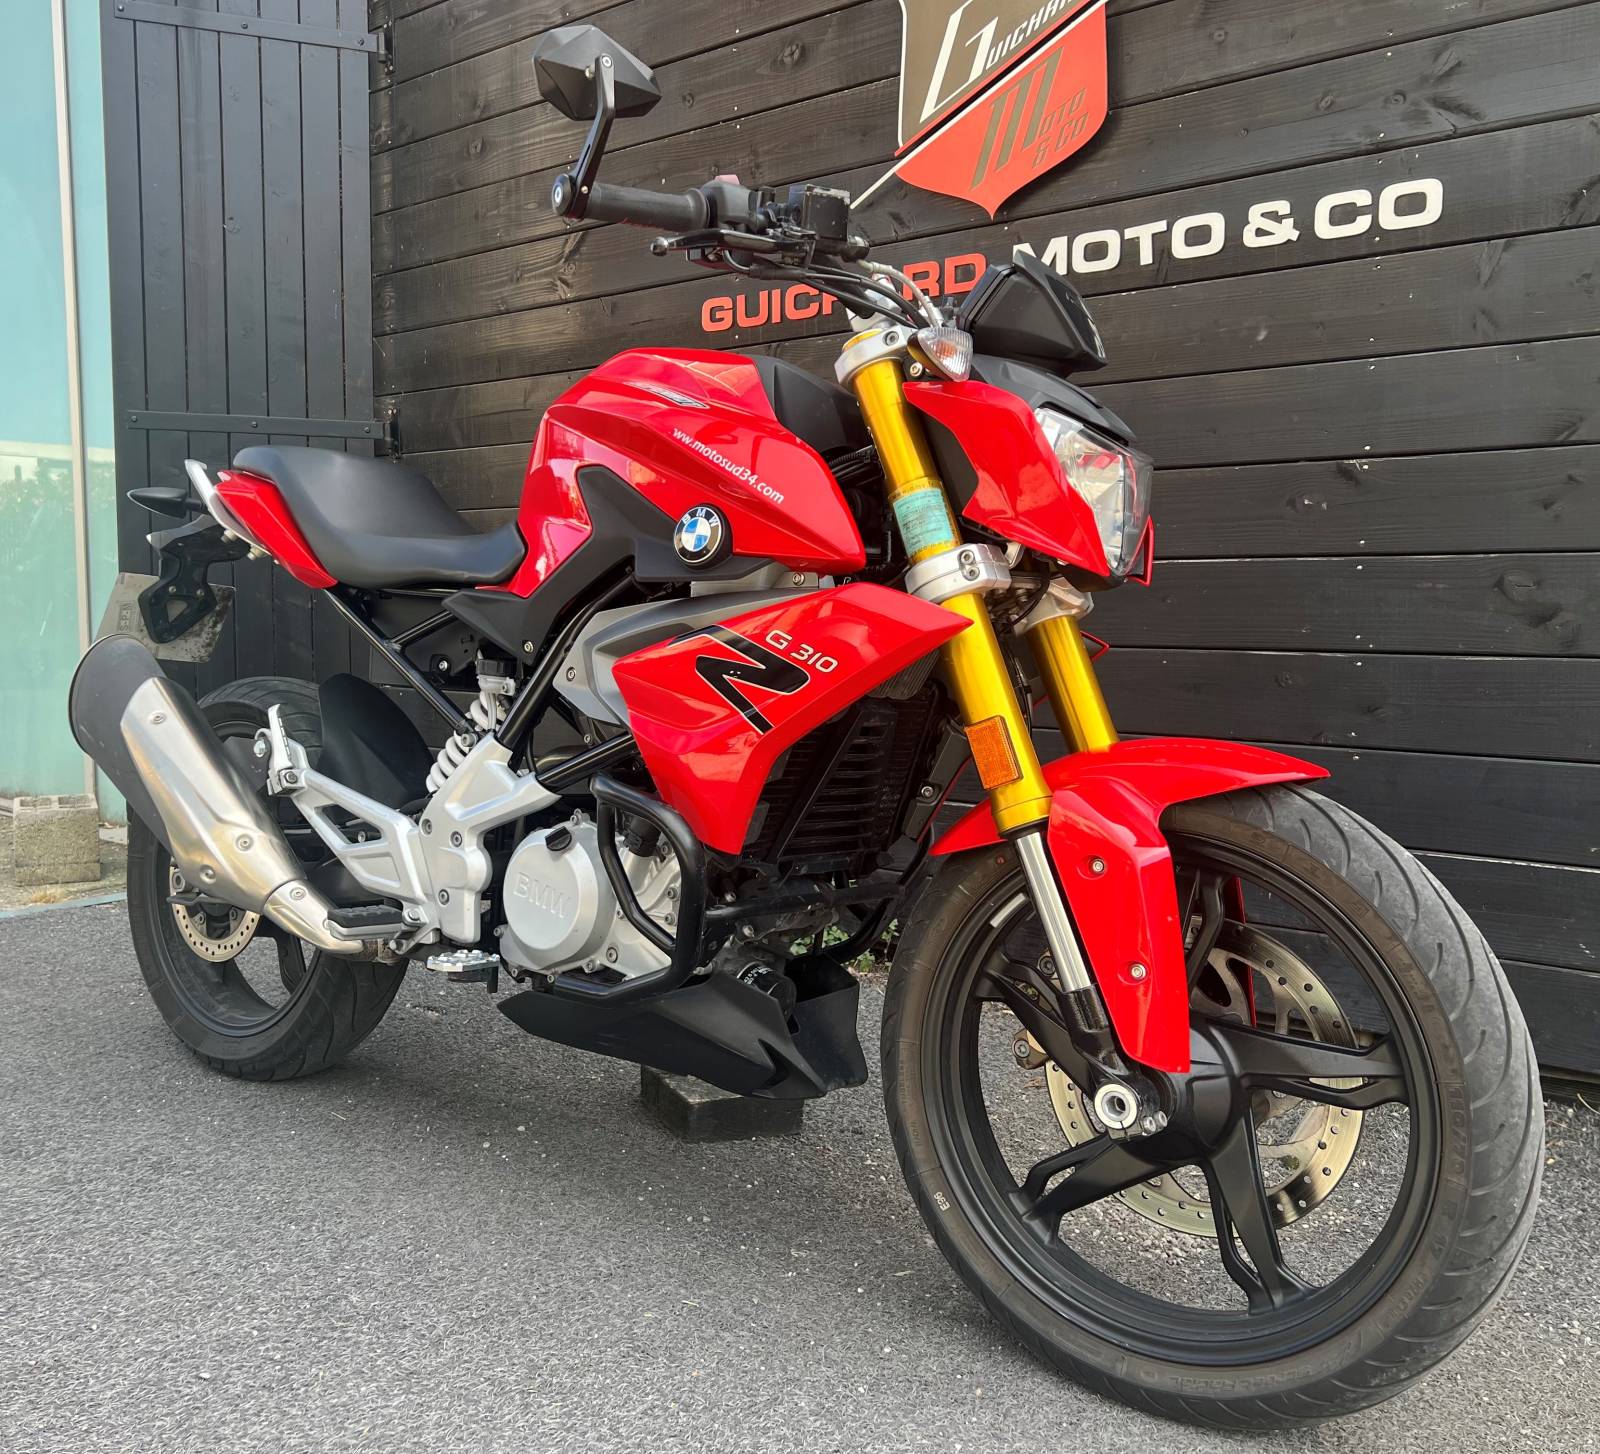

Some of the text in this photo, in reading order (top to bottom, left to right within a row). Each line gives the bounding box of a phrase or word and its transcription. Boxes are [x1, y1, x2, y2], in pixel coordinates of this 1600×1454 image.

[701, 178, 1443, 332] GUICRD MOTO & CO
[681, 507, 721, 528] BMW
[765, 629, 839, 673] G 310
[512, 871, 571, 919] BMW
